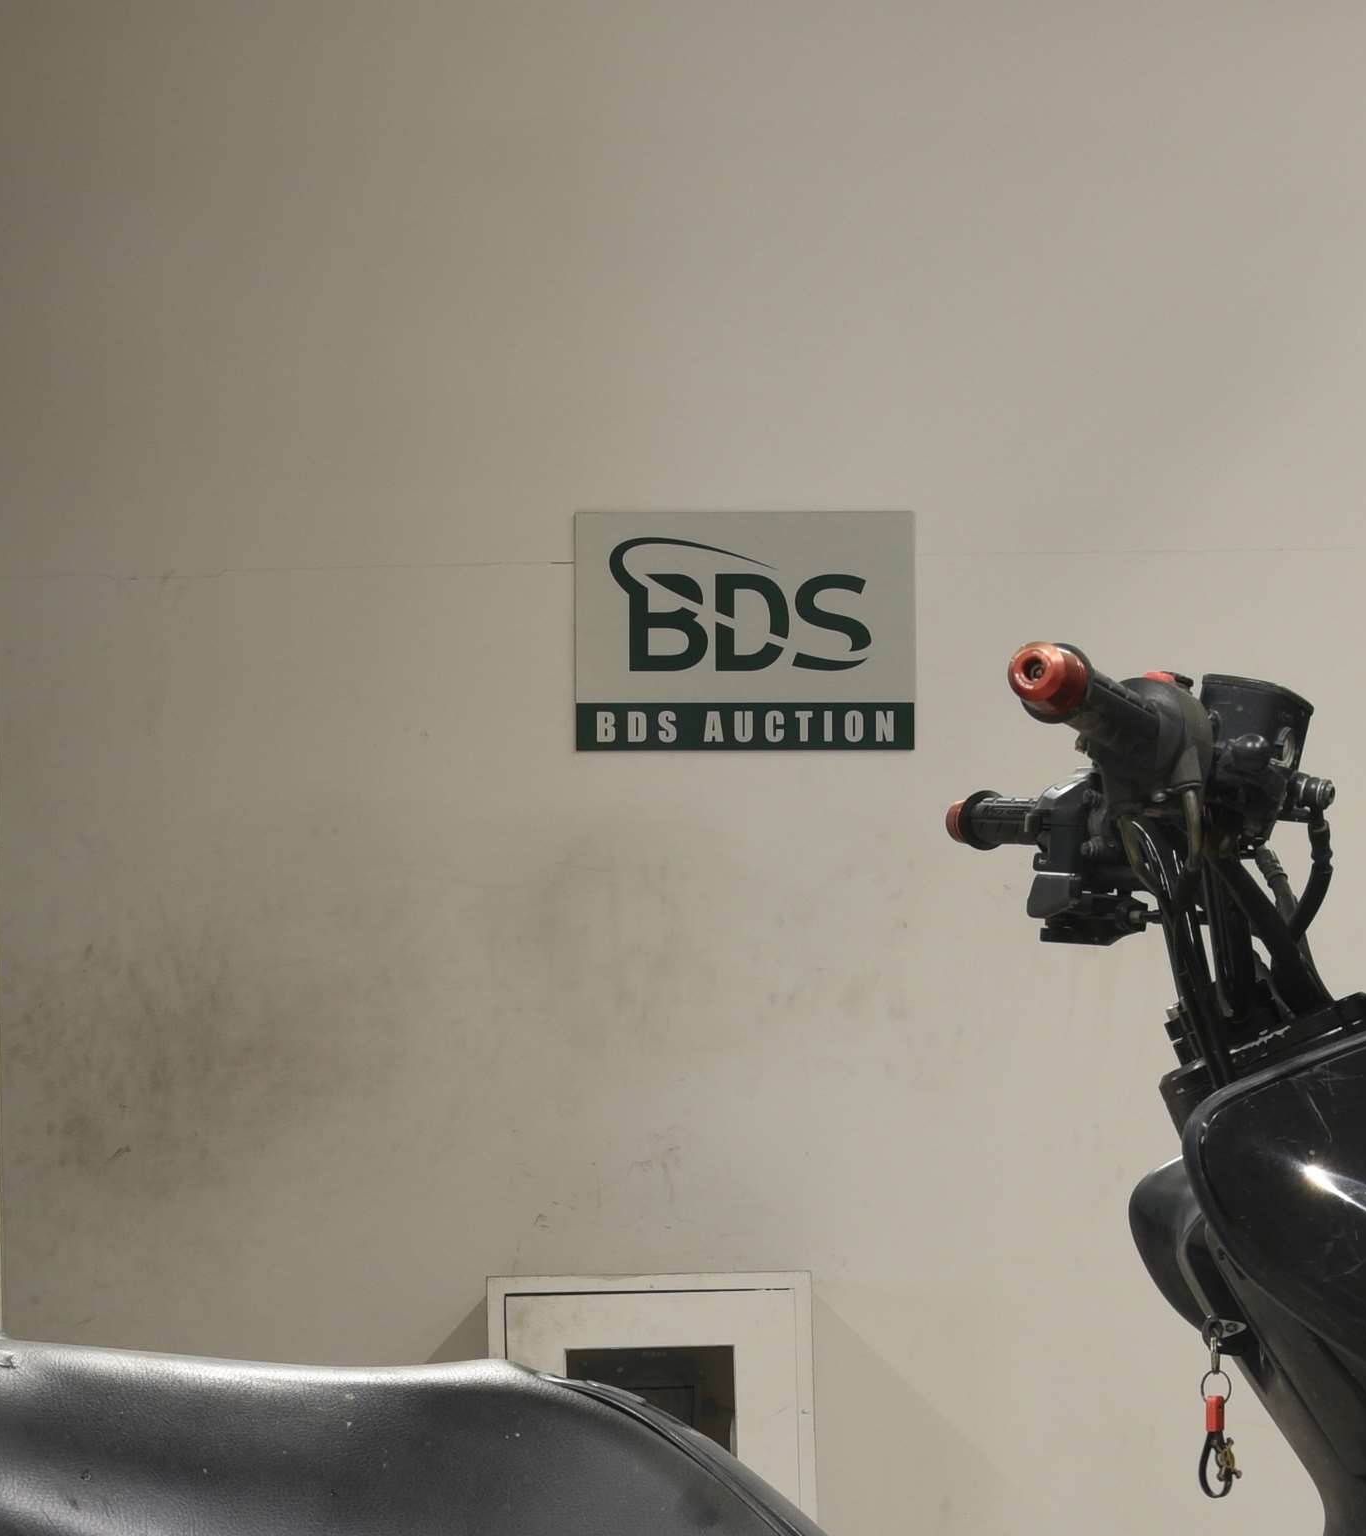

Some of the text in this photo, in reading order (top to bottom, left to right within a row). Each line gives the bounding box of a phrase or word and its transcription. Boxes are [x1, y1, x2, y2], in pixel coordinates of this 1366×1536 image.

[609, 537, 872, 671] BDS
[596, 710, 895, 743] BDS AUCTION
